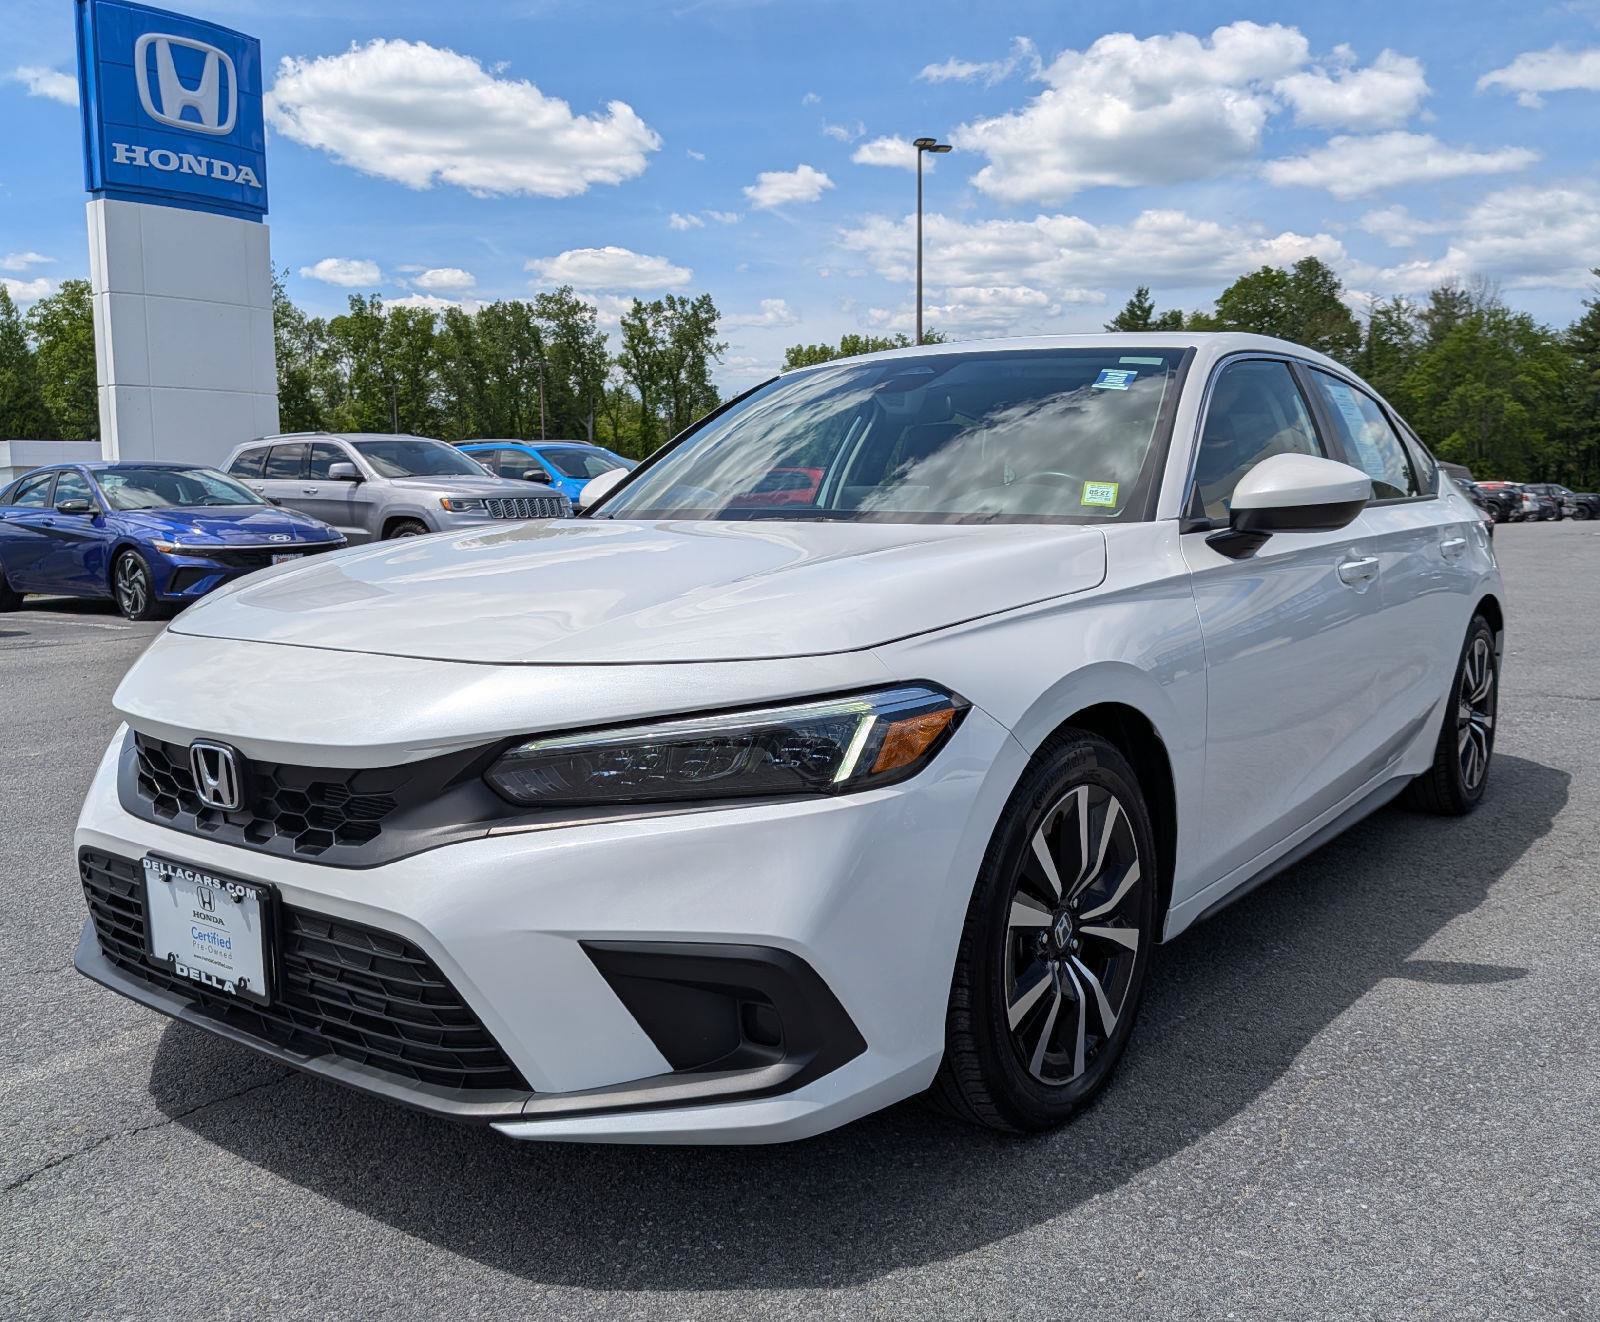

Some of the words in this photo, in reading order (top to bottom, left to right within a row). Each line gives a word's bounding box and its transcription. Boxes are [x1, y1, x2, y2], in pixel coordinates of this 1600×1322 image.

[112, 142, 262, 188] HONDA
[142, 858, 257, 900] DELLACARS.COM
[192, 910, 225, 926] HONDA
[191, 926, 232, 950] Certified
[192, 940, 232, 960] Pre-Owned
[175, 961, 237, 995] DELLA
